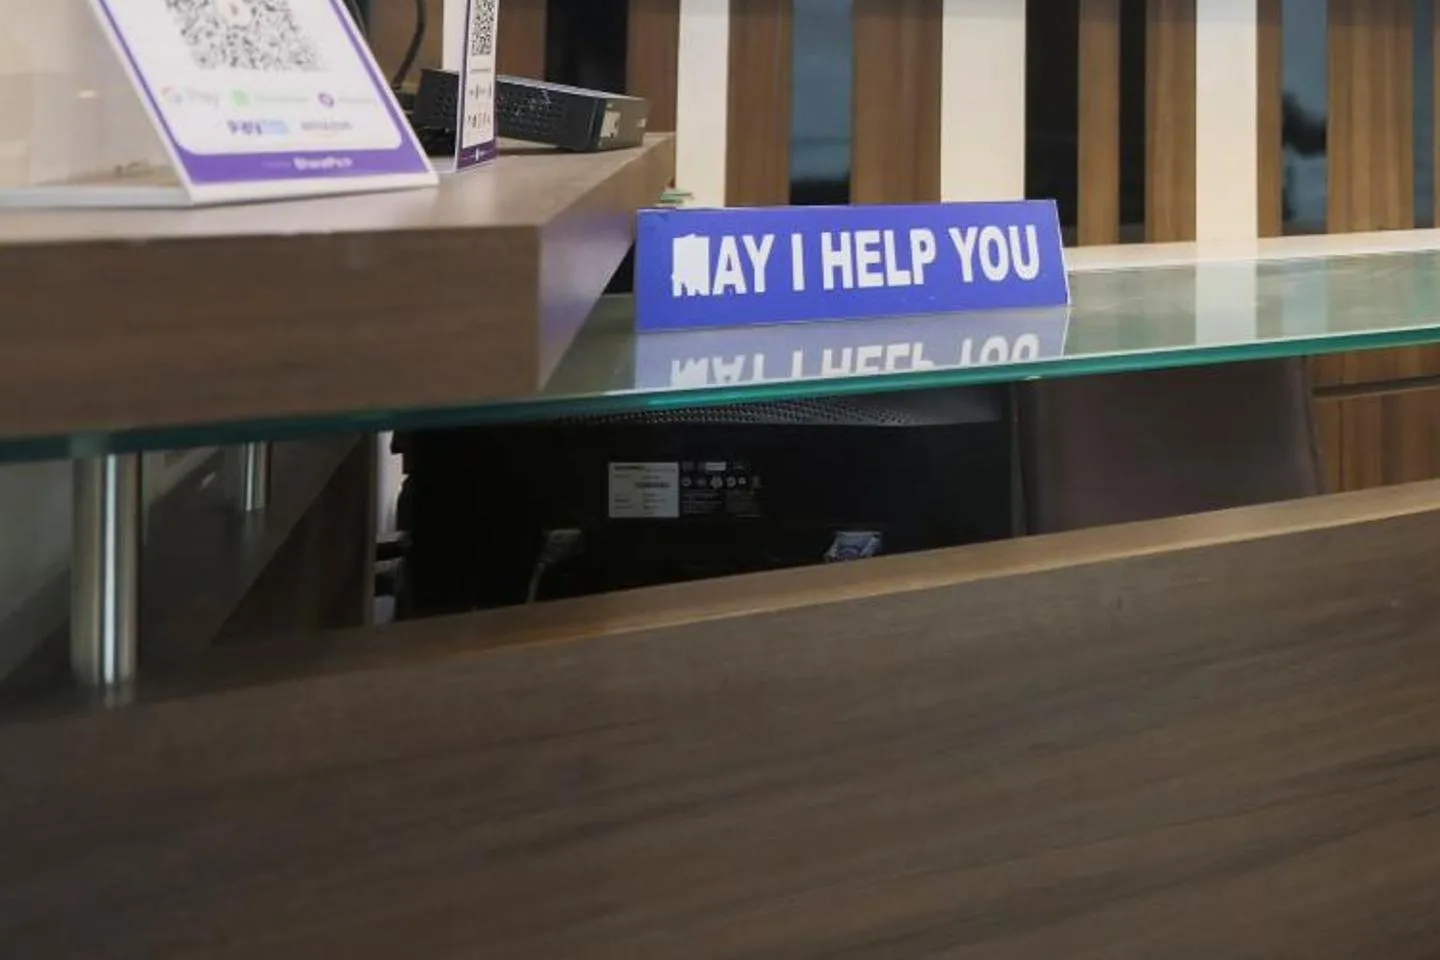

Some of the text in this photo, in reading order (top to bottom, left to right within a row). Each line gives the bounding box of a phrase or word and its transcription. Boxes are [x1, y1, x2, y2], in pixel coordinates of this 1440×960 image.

[791, 233, 805, 292] I
[821, 228, 938, 291] HELP
[948, 224, 1041, 283] YOU
